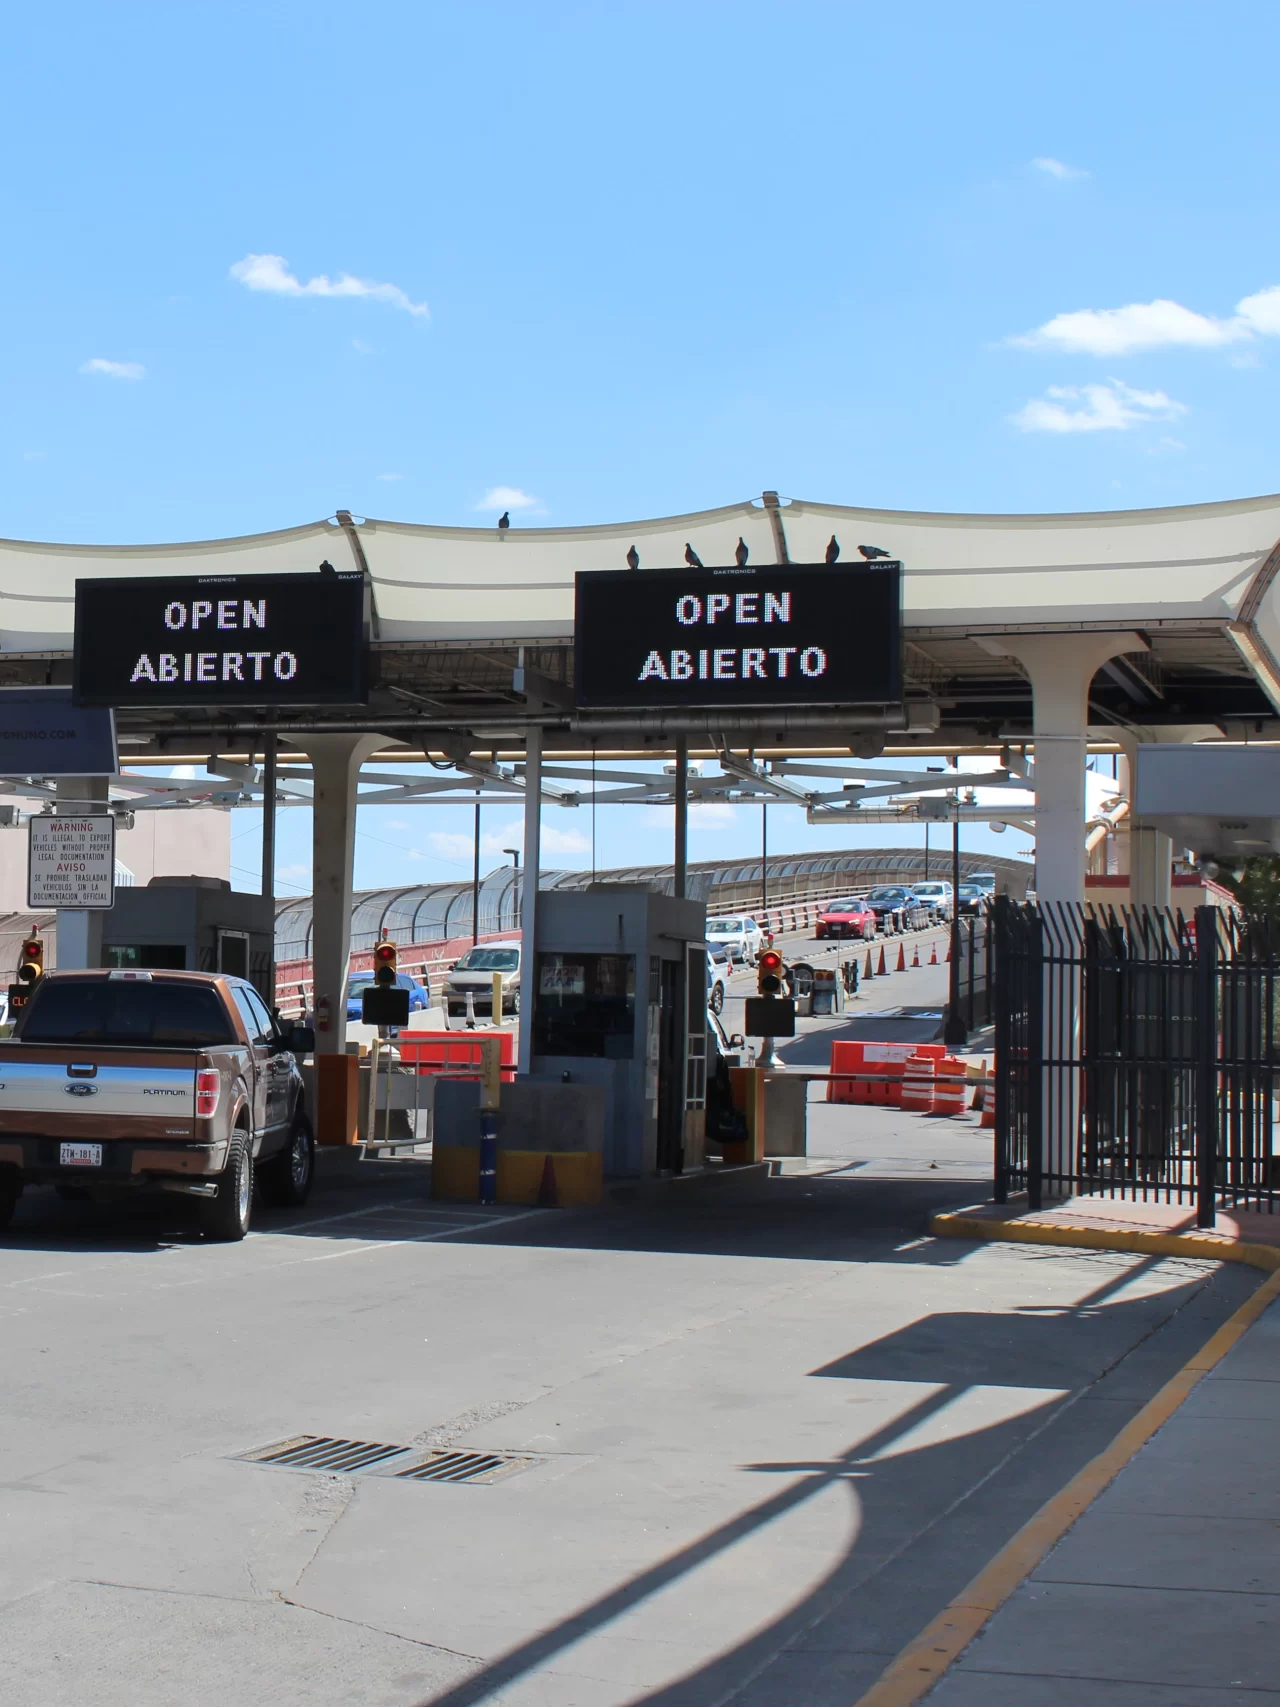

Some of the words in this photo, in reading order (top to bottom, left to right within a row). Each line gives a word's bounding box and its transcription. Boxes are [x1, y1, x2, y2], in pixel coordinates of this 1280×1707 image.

[676, 591, 792, 625] OPEN
[164, 599, 266, 630] OPEN
[129, 651, 298, 682] ABIERTO
[637, 646, 827, 681] ABIERTO
[51, 823, 93, 832] WARNING
[33, 834, 38, 842] IT
[42, 834, 48, 842] IS
[90, 843, 110, 851] PROPER
[38, 853, 55, 861] LEGAL
[60, 853, 105, 861] DOCUMENTATION
[56, 863, 86, 872] AVISO
[34, 874, 41, 882] SE
[46, 874, 69, 882] PROHIBE
[75, 874, 108, 882] TRASLADAR
